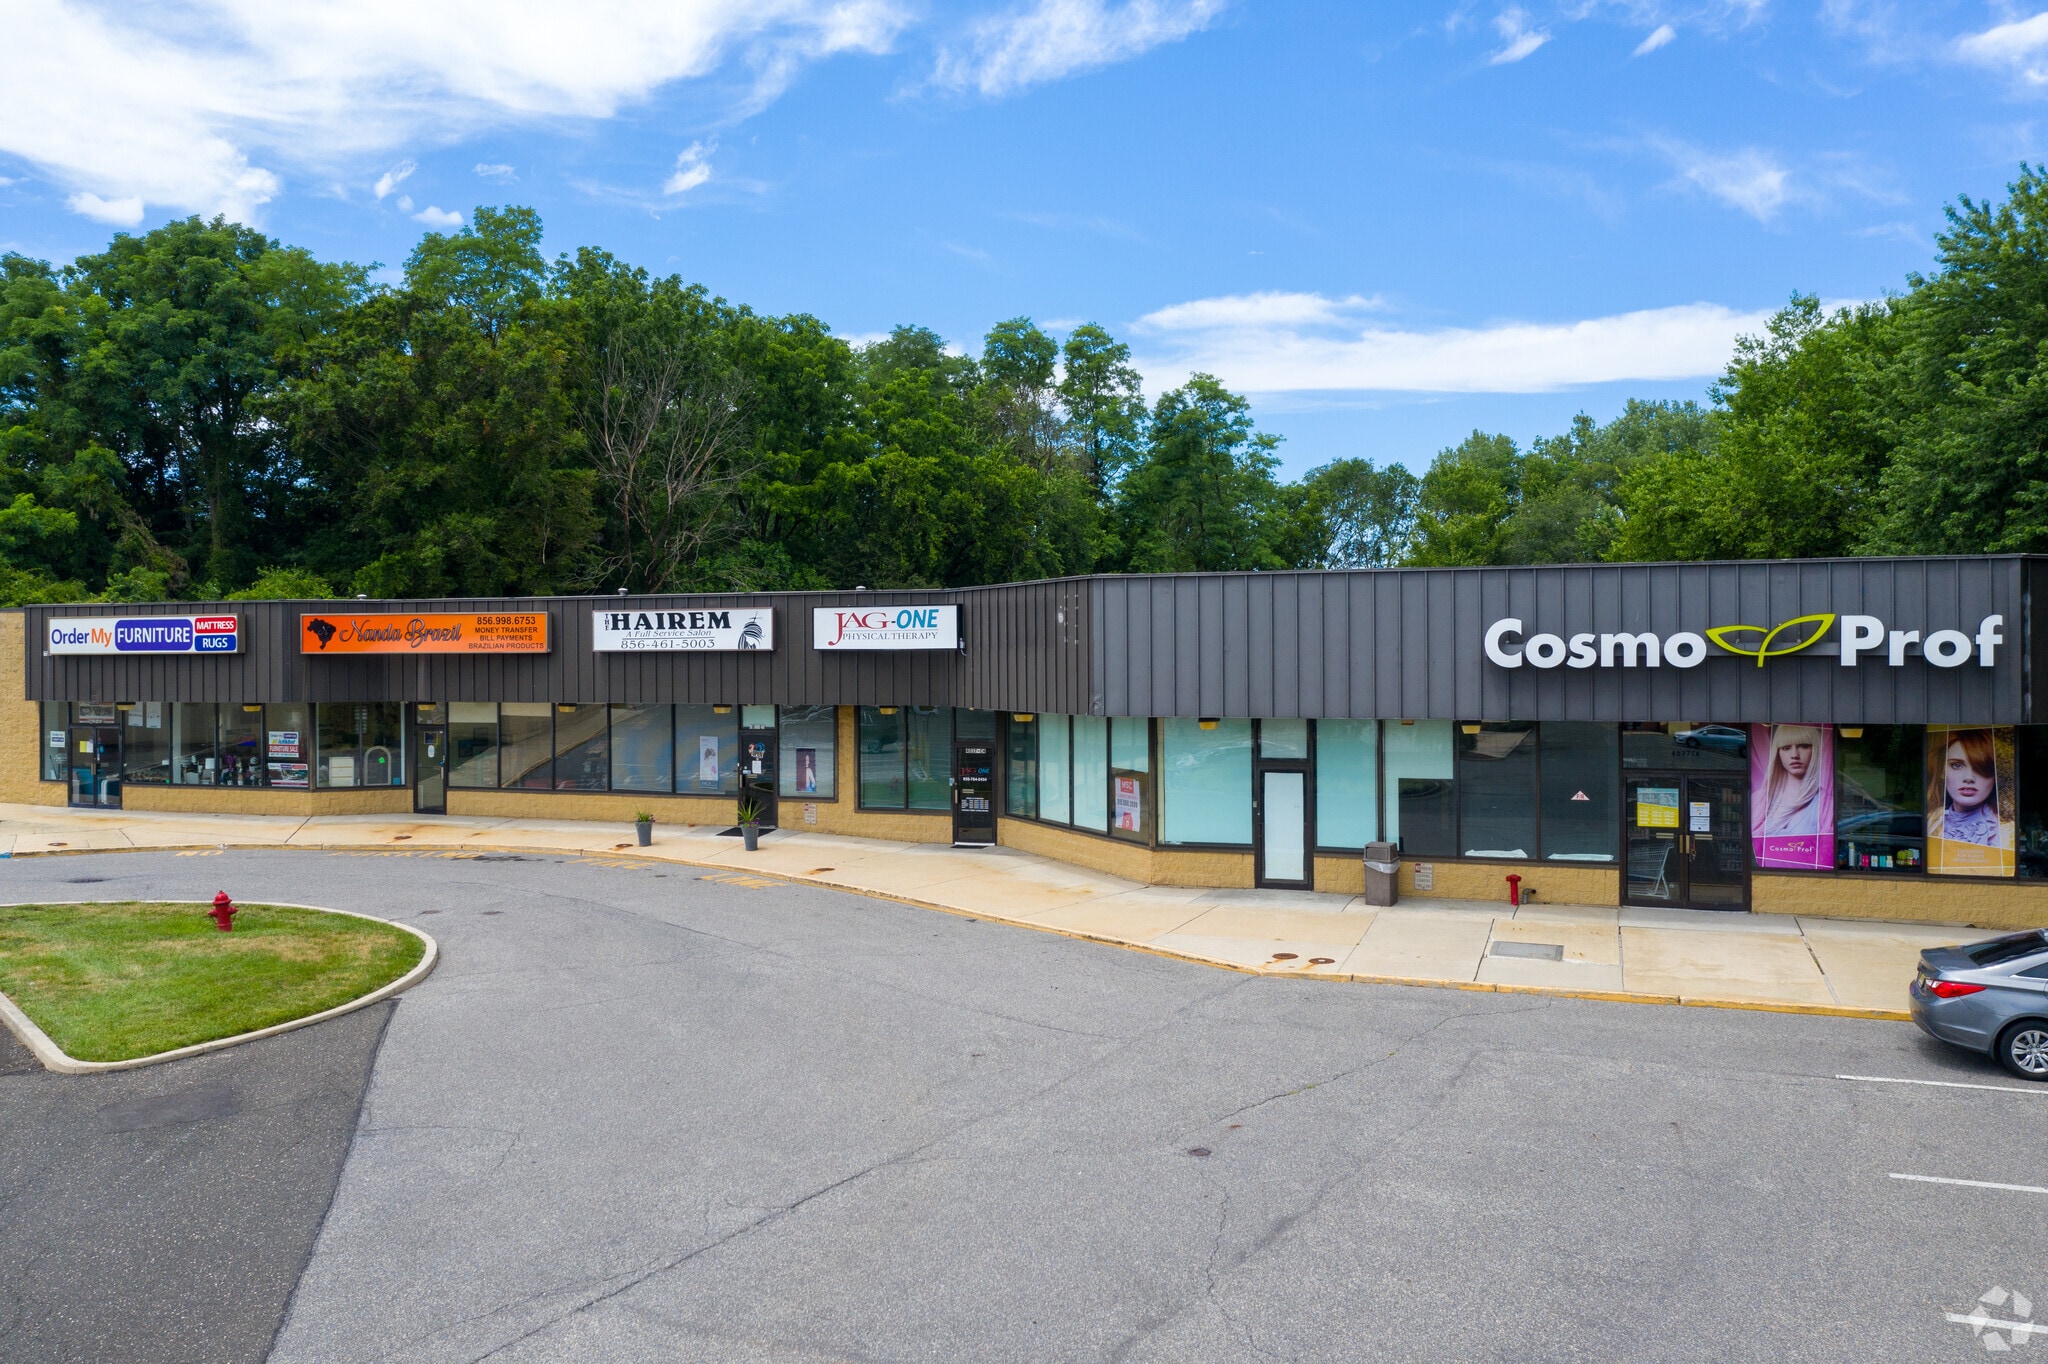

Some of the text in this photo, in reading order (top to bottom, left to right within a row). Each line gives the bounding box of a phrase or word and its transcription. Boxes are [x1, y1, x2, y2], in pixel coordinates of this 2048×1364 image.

[196, 620, 235, 630] MATTRESS
[476, 616, 536, 625] 856.998.6753
[611, 611, 731, 630] HAIREM
[474, 626, 500, 634] MONEY
[653, 629, 685, 637] Service
[828, 608, 939, 646] JAG-ONE
[51, 626, 191, 648] Order My FURNITURE
[339, 618, 463, 649] Nanda Brazil
[842, 631, 938, 641] PHYSICAL THERAPY
[202, 637, 228, 649] RUGS
[620, 638, 716, 650] 856-461-5003
[1484, 614, 2004, 669] Cosmo Prof
